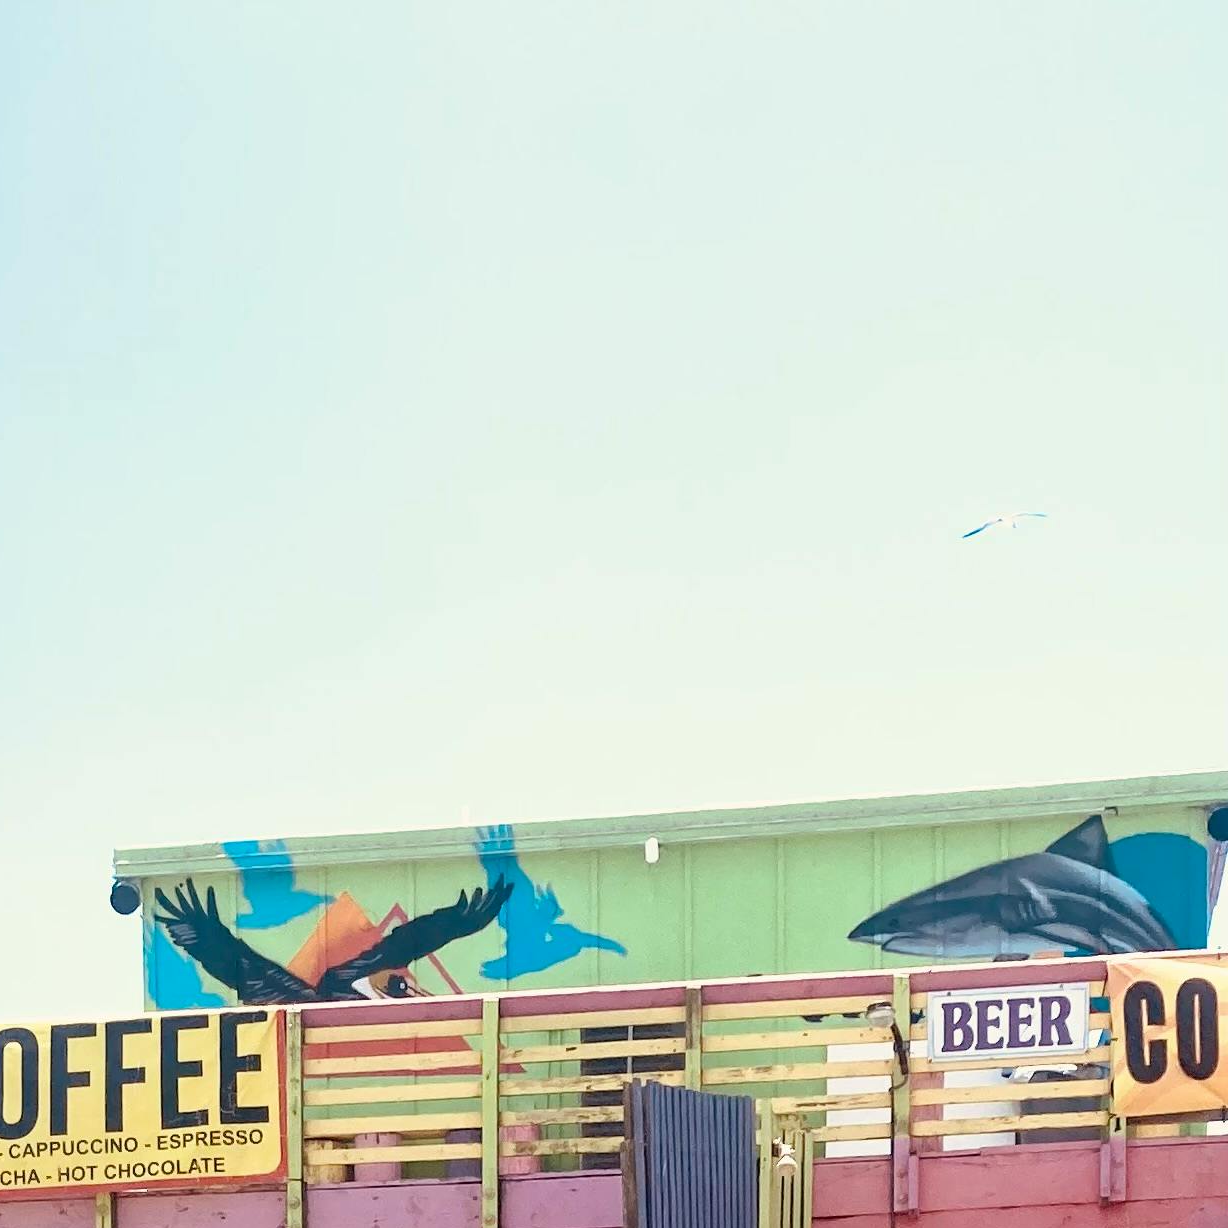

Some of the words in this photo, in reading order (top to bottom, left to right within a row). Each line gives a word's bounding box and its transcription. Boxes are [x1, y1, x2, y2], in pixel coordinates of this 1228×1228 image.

[941, 995, 1074, 1053] BEER
[1123, 977, 1220, 1084] CO
[8, 1137, 139, 1159] CAPPUCCINO
[157, 1129, 264, 1151] ESPRESSO
[57, 1165, 99, 1183] HOT
[104, 1157, 226, 1180] CHOCOLATE
